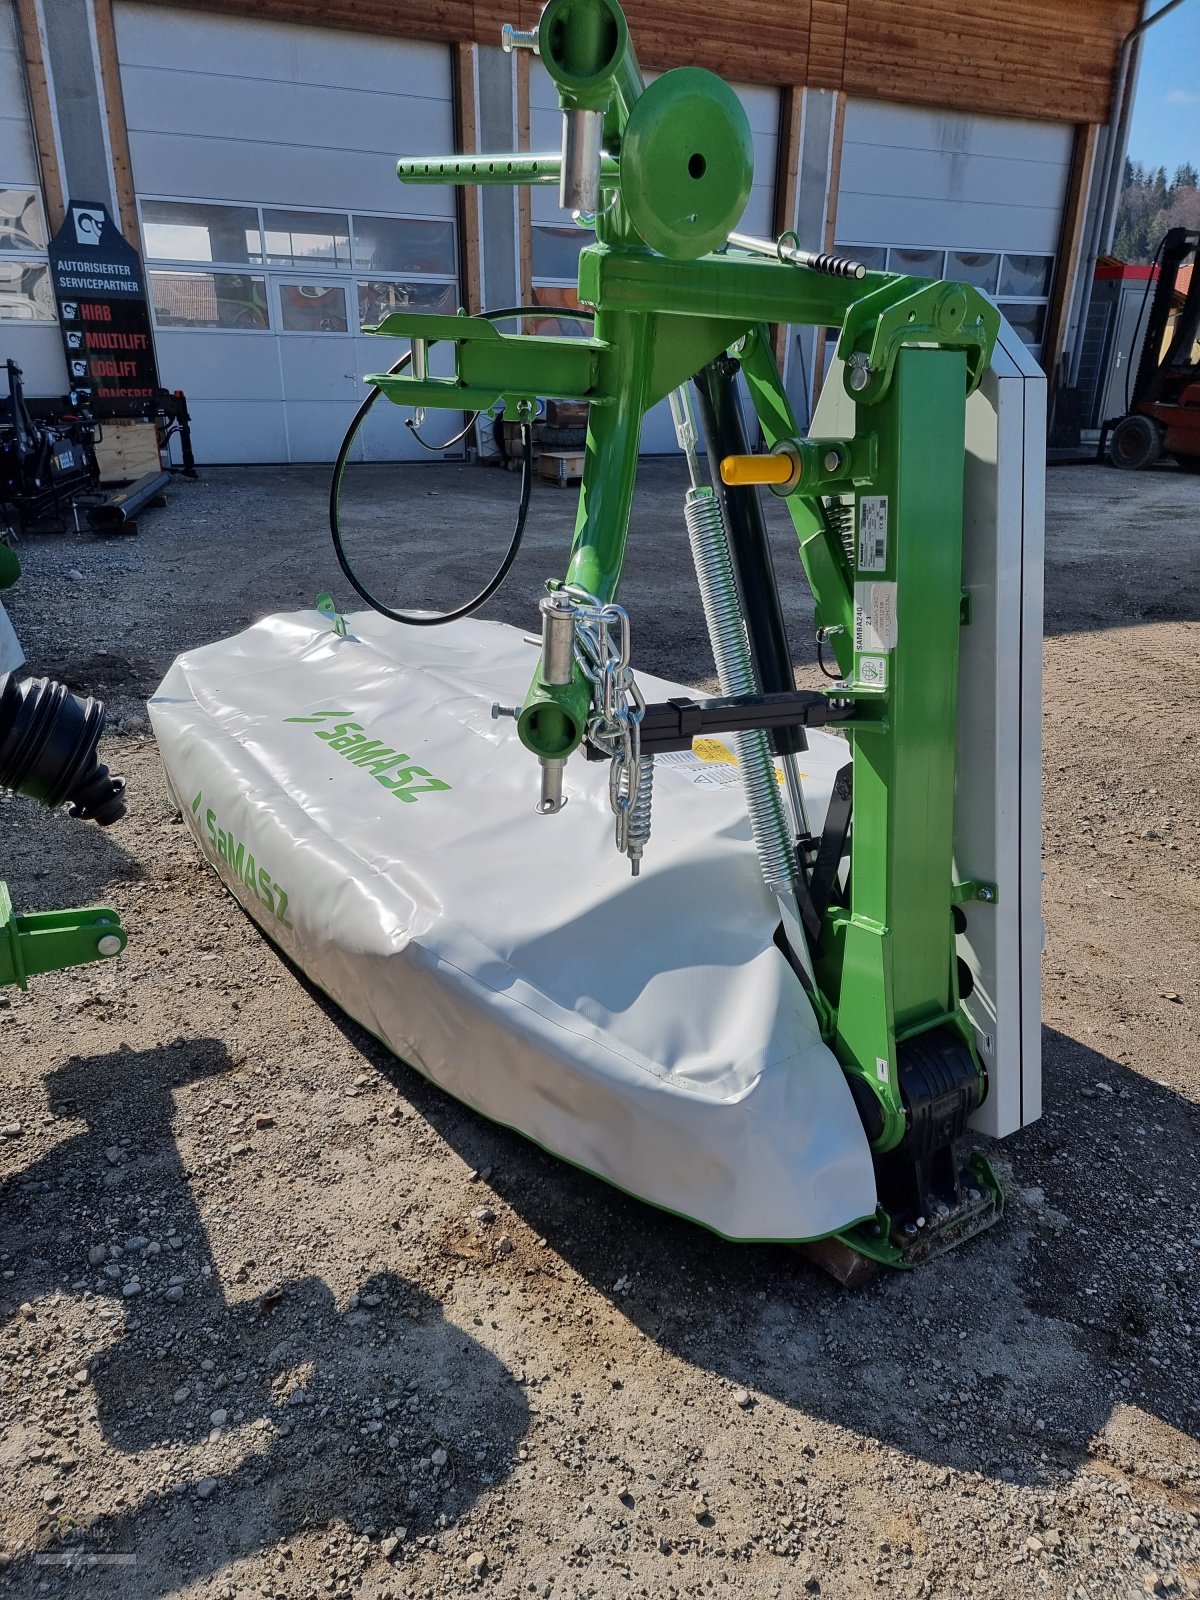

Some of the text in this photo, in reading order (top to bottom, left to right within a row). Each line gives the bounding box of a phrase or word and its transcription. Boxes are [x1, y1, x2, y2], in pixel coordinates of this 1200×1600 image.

[57, 260, 131, 276] AUTORISIERTER
[60, 277, 139, 292] SERVICEPARTNER
[81, 303, 112, 321] HIAB
[86, 332, 147, 350] MULTILIFT
[90, 360, 137, 376] LOGLIFT
[865, 616, 871, 626] 21
